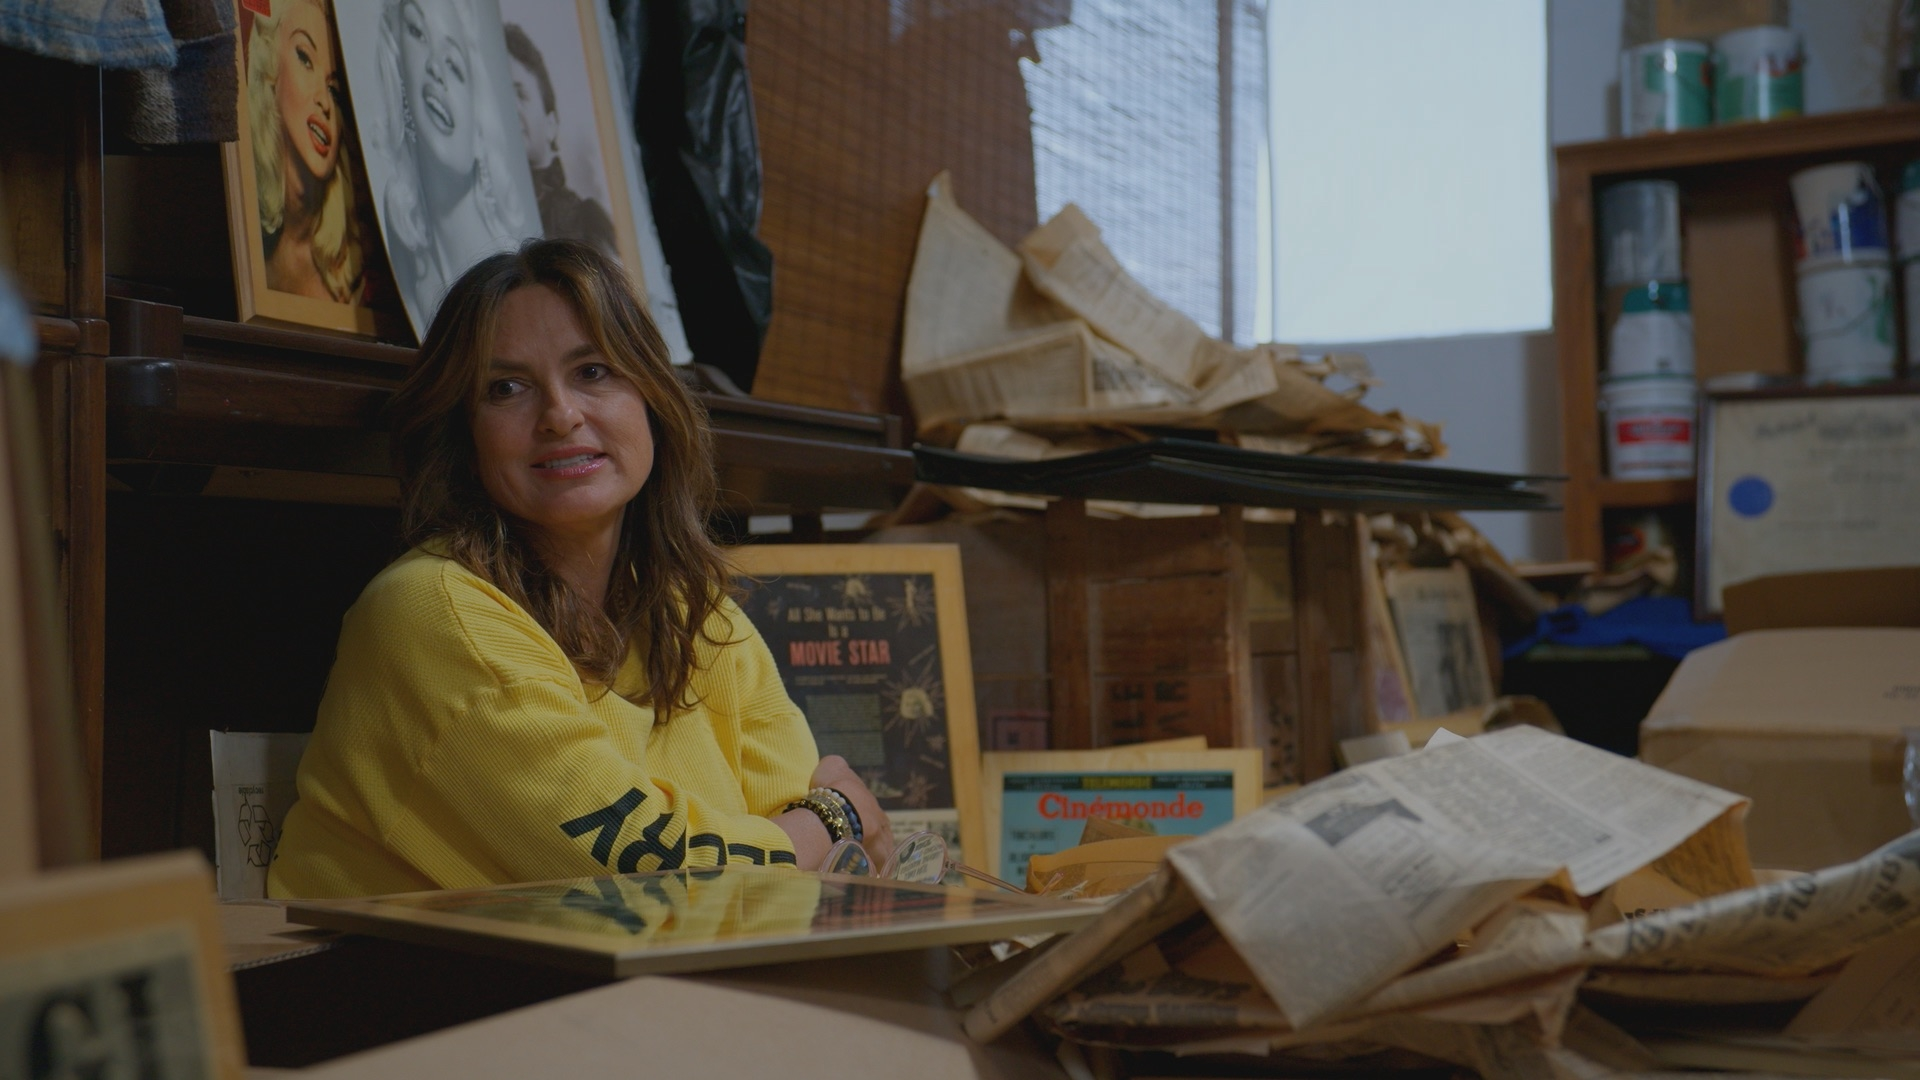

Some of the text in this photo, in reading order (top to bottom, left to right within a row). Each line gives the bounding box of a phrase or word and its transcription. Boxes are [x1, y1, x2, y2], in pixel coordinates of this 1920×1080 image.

[803, 607, 823, 622] She
[825, 606, 857, 622] Wants
[789, 639, 891, 667] MOVIE STAR
[1037, 791, 1204, 820] Cinémonde
